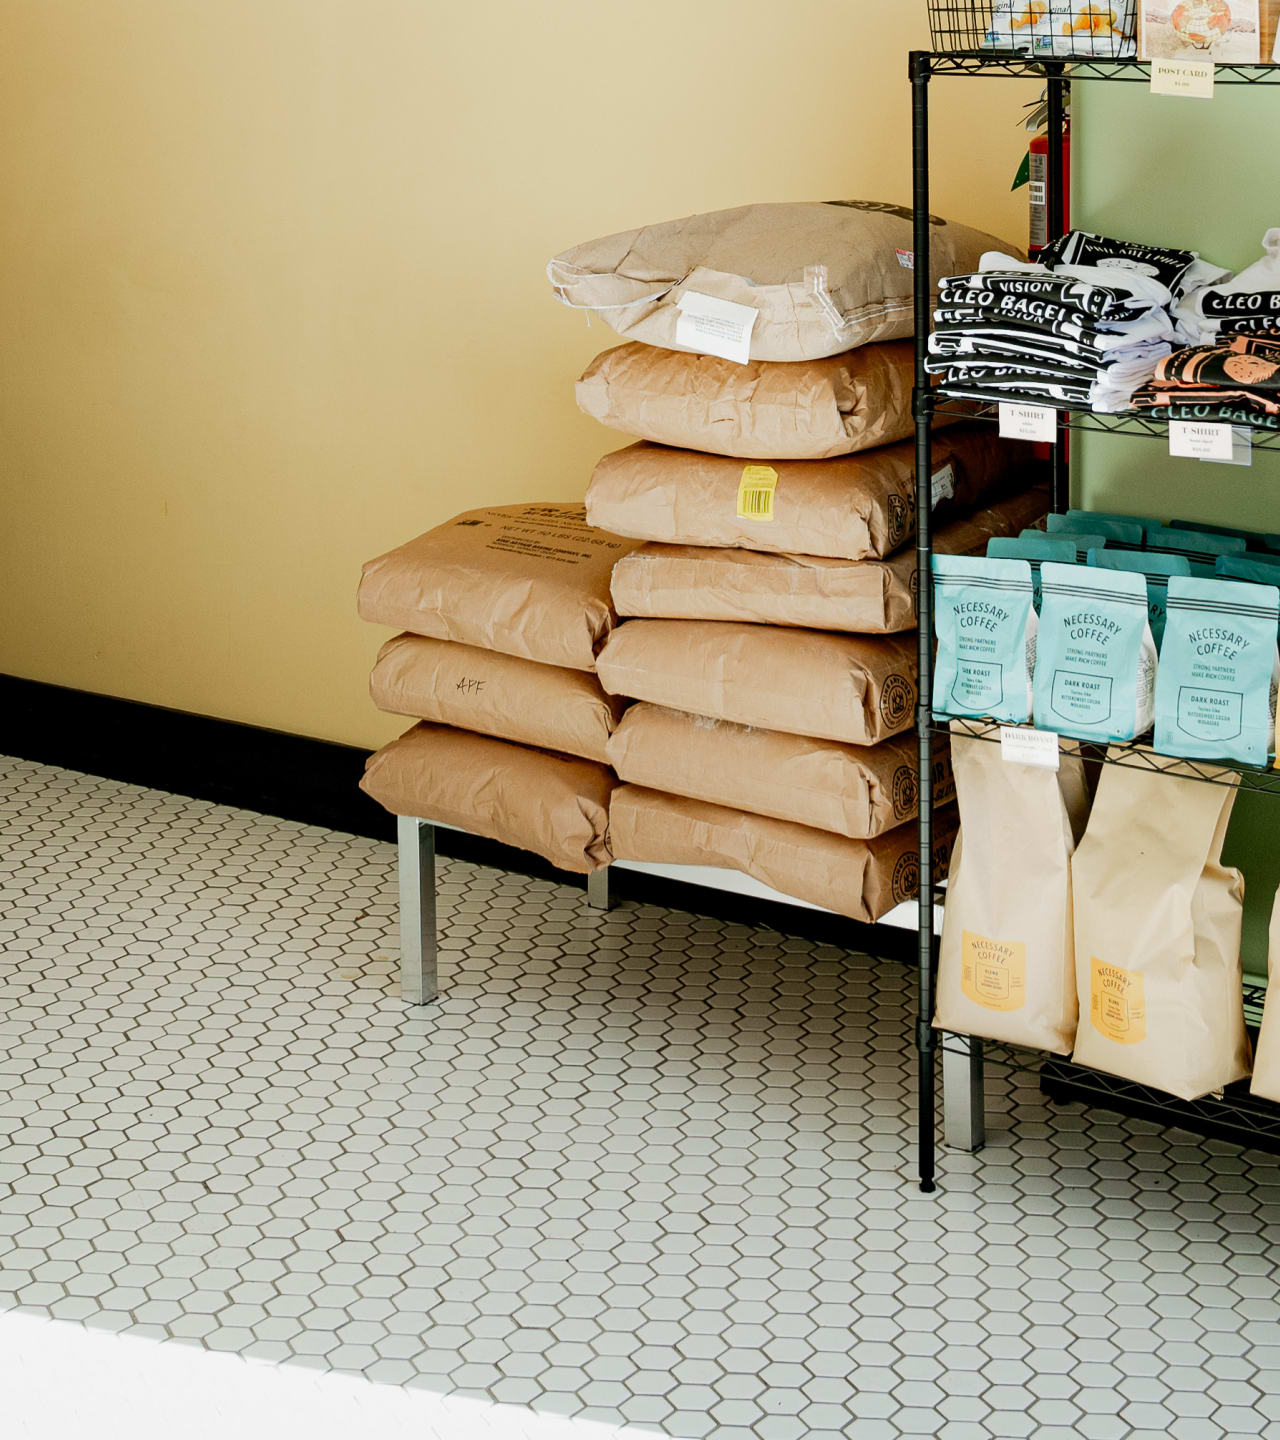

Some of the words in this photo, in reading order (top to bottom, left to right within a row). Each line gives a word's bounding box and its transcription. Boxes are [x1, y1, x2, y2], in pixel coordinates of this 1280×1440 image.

[999, 281, 1054, 293] VISION
[939, 288, 996, 307] CLEO
[1000, 294, 1085, 327] BAGELS
[1211, 292, 1263, 312] CLEO
[953, 600, 1010, 623] NECESSARY
[959, 615, 999, 634] COFFEE
[1063, 612, 1122, 636] NECESSARY
[1069, 628, 1111, 647] COFFEE
[1188, 627, 1251, 651] NECESSARY
[1196, 643, 1238, 662] COFFEE
[1190, 694, 1208, 705] DARK
[1208, 696, 1230, 707] ROAST
